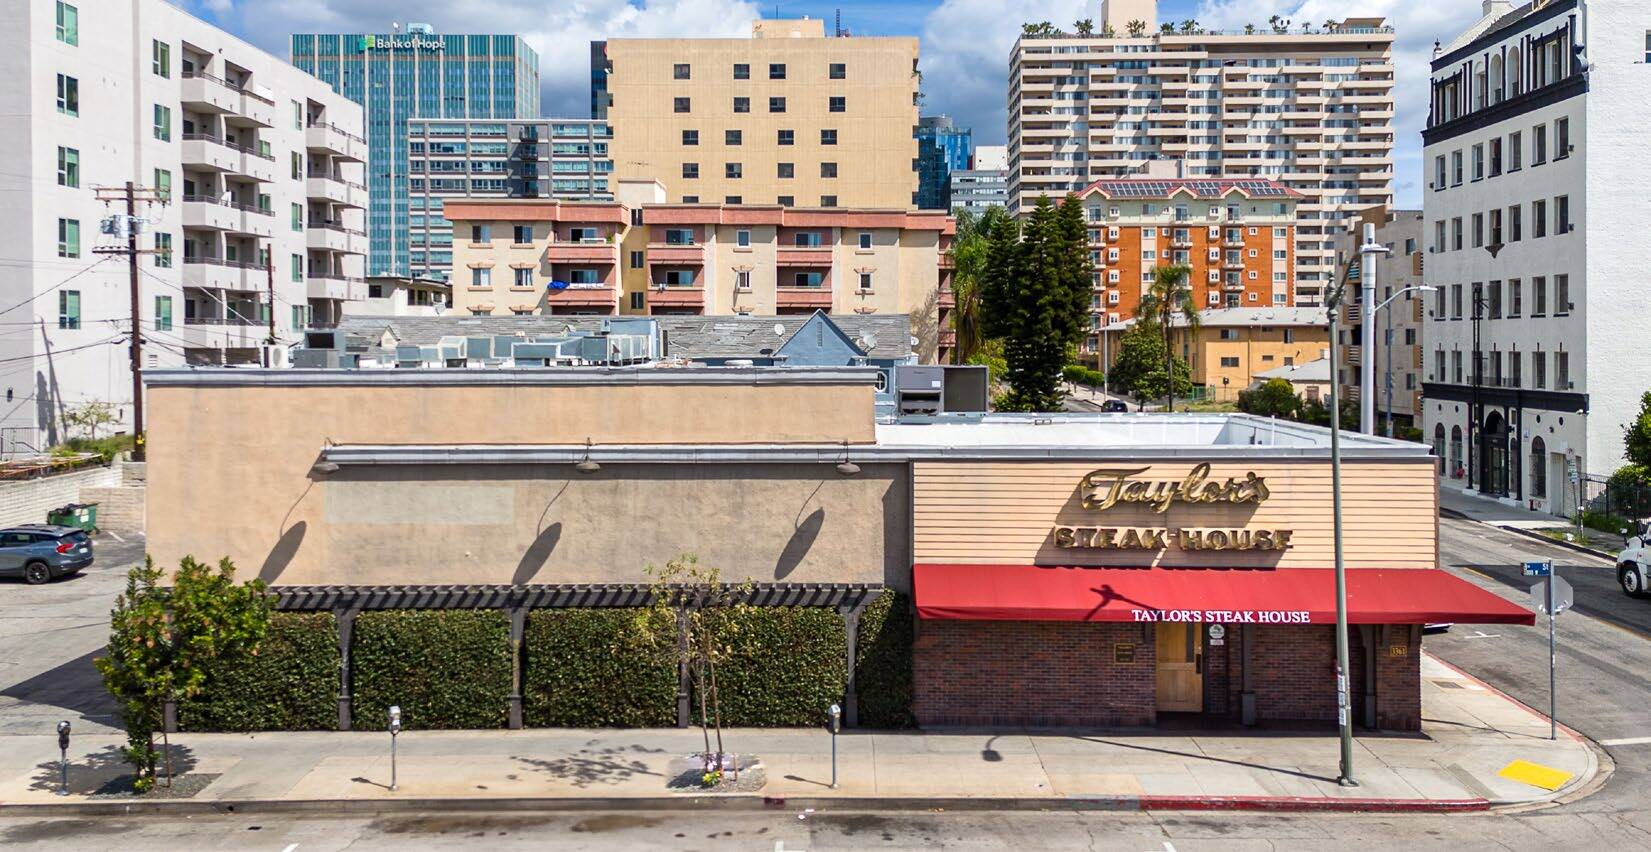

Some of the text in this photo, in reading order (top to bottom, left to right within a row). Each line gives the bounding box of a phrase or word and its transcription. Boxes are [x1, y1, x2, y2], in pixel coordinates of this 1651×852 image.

[377, 39, 446, 51] Bank of Hope
[1080, 462, 1271, 513] Taylor's
[1054, 527, 1294, 550] STEAK HOUSE
[1131, 609, 1311, 624] TAYLOR'S STEAK HOUSE
